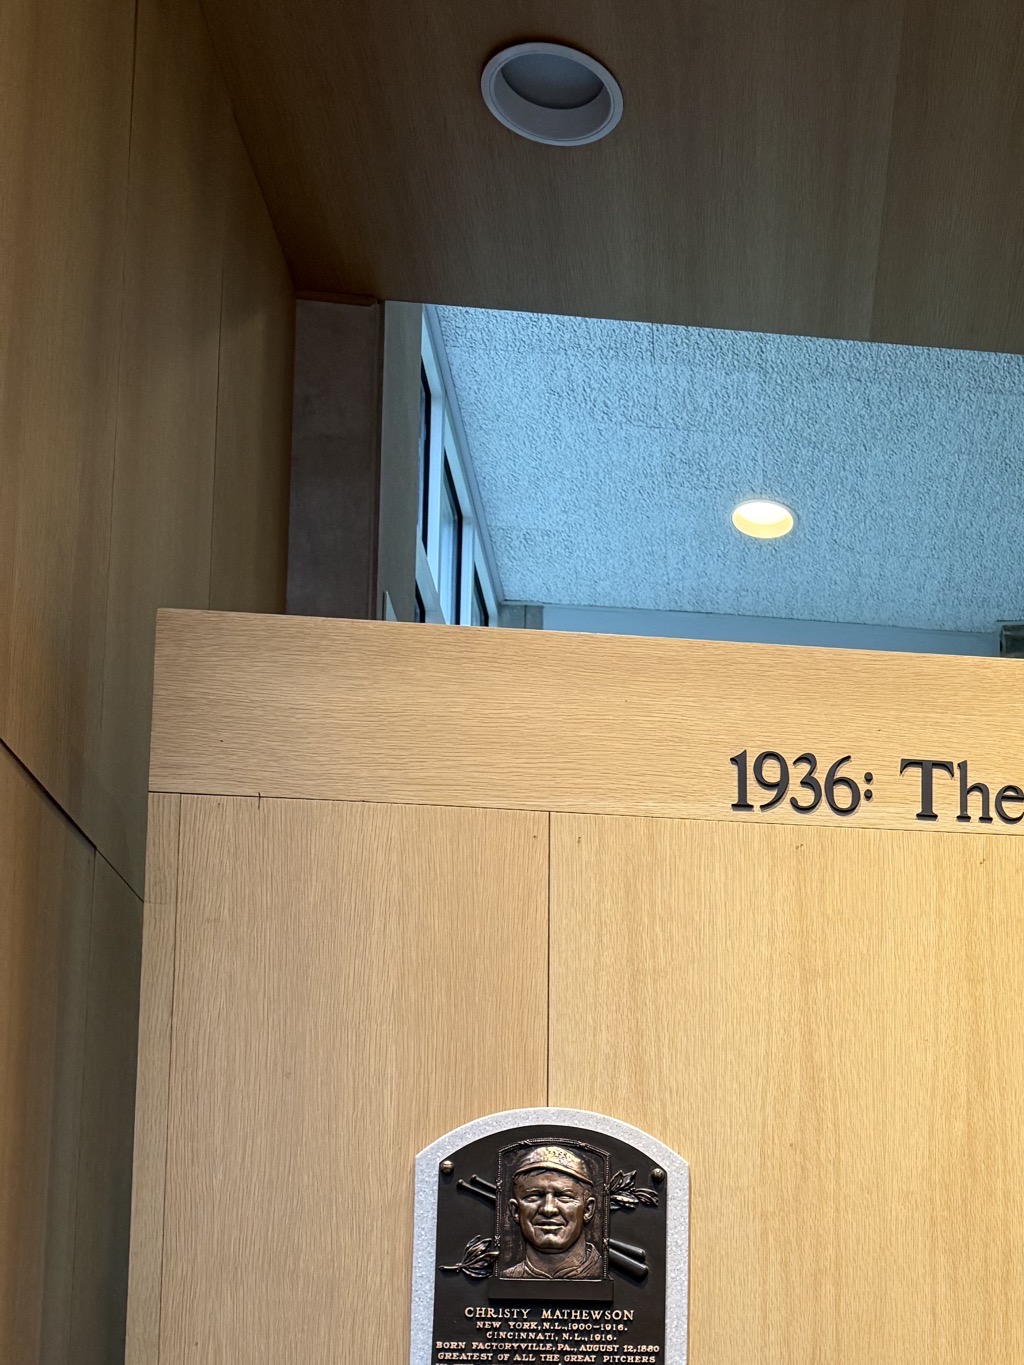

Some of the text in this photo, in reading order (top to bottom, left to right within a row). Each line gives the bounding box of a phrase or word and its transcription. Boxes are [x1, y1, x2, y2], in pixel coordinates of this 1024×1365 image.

[729, 748, 873, 817] 1936:
[465, 1307, 634, 1320] CHRISTY MATHEWSON
[438, 1352, 493, 1360] GREATEST
